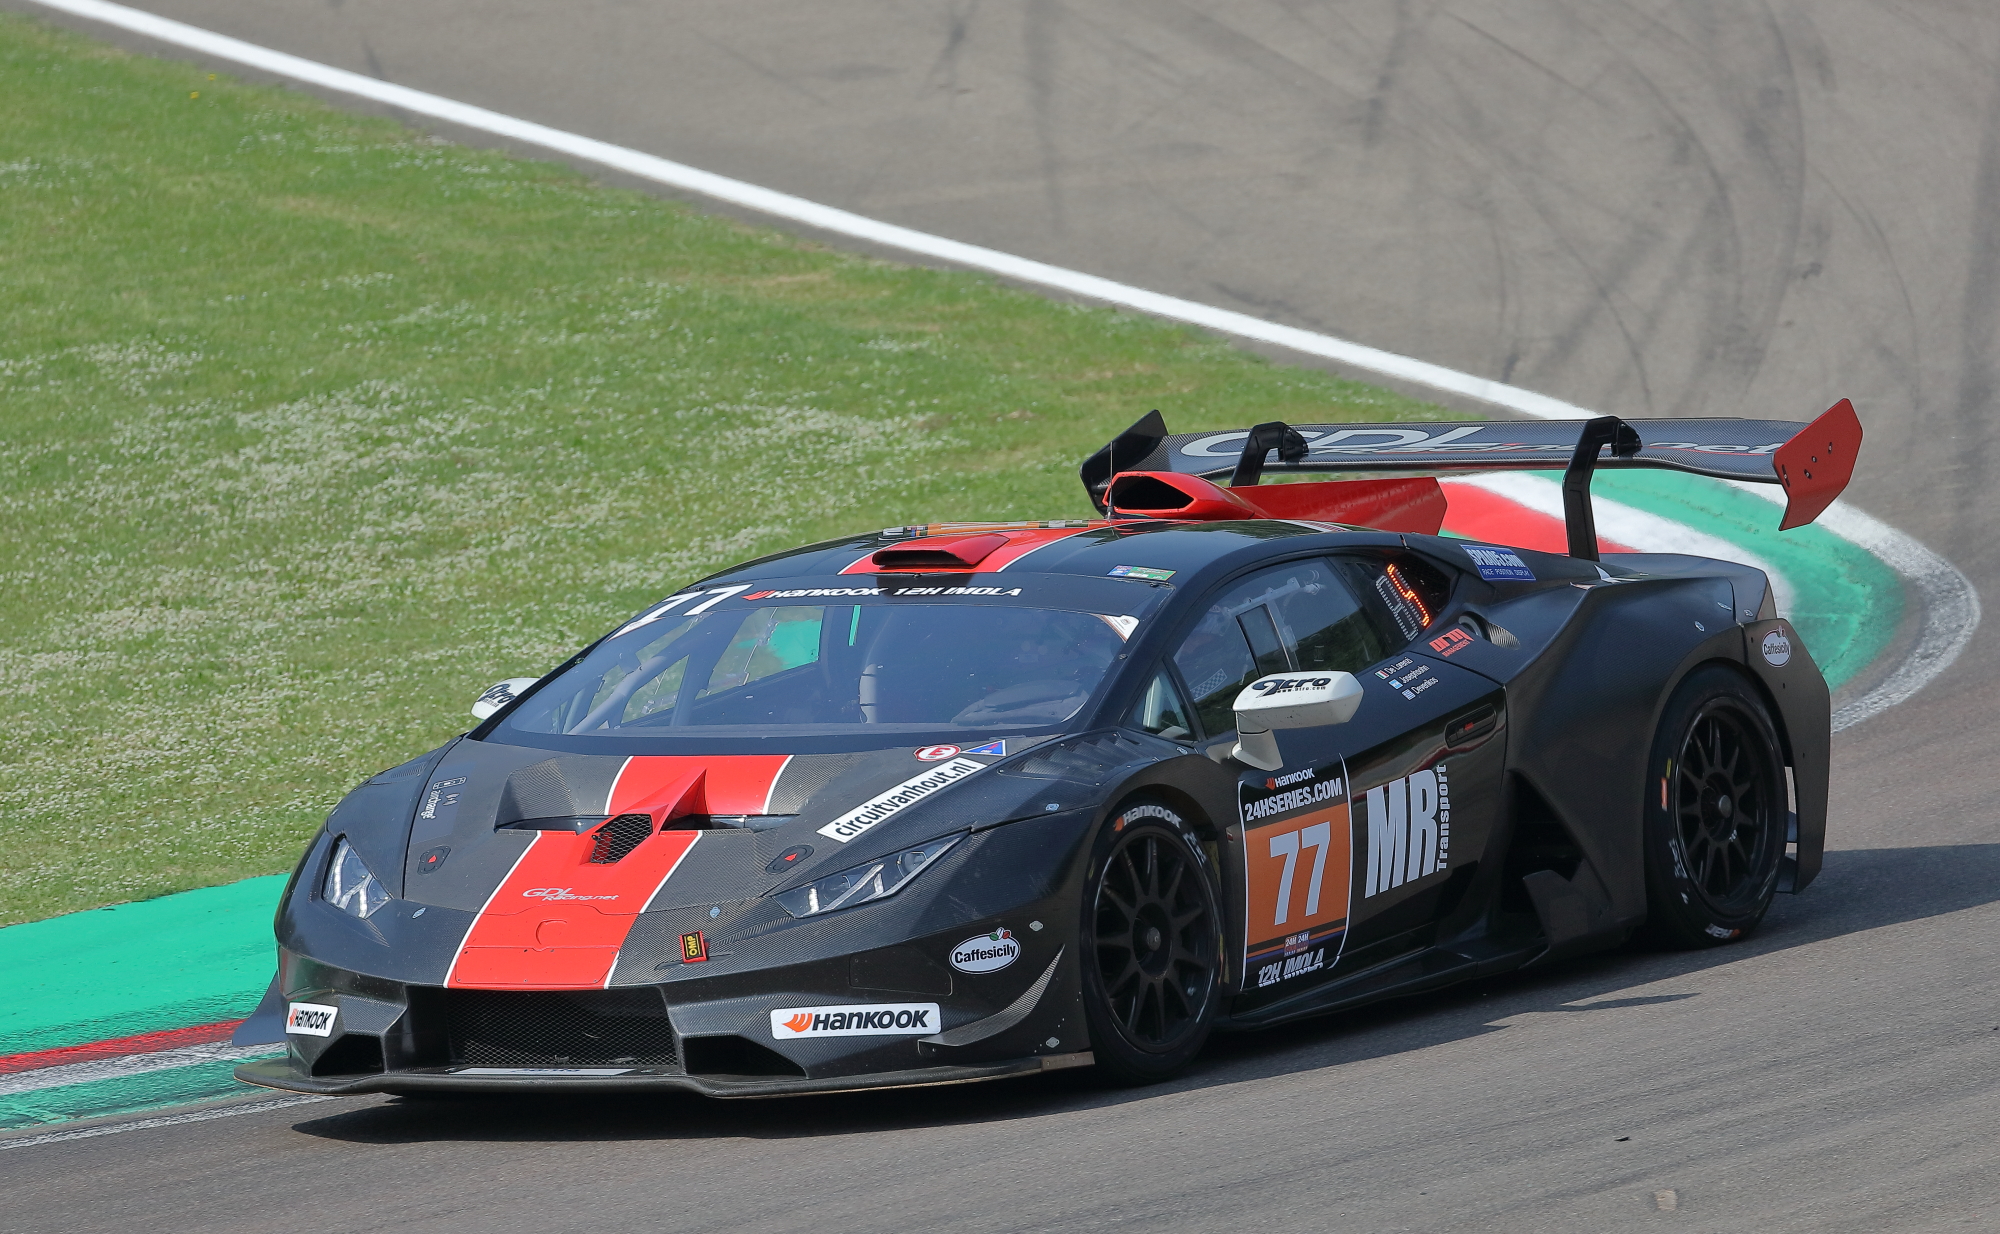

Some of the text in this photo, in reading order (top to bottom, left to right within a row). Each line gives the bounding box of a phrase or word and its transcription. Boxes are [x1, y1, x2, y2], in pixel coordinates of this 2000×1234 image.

[892, 586, 943, 596] 12H
[943, 586, 1023, 597] IMOLA
[834, 761, 978, 837] circuitvanhout.nl
[1244, 777, 1343, 822] 24HSERIES.COM
[1436, 764, 1450, 872] Transport
[1364, 768, 1438, 899] MR
[522, 887, 575, 898] GDL
[1269, 821, 1331, 926] 77
[688, 934, 699, 957] OMP
[953, 943, 1017, 965] Caffesicily
[1258, 947, 1325, 988] 12H IMOLA
